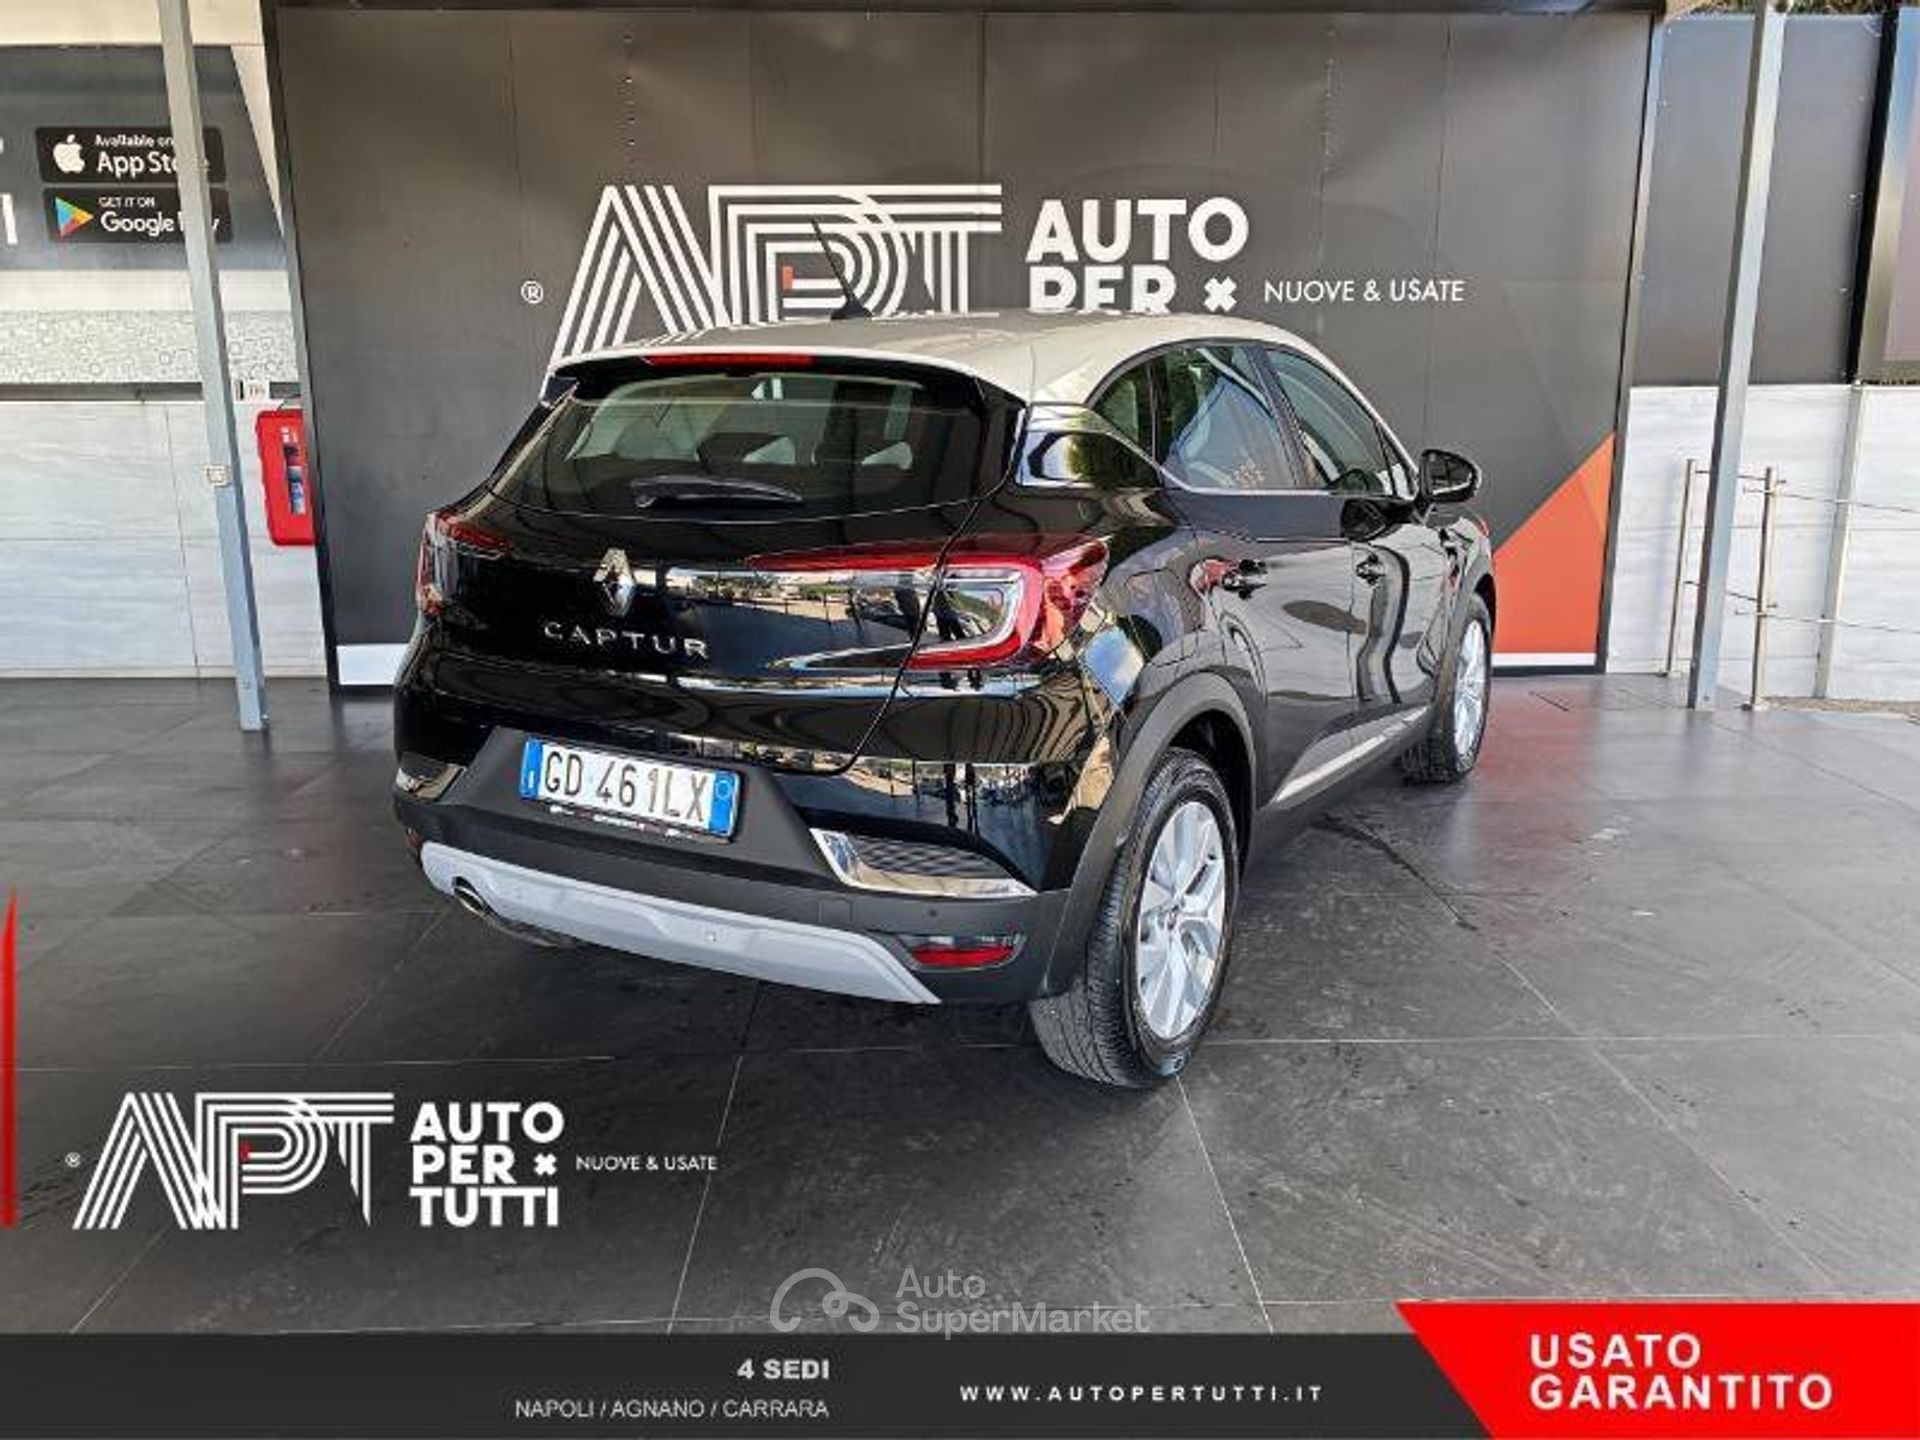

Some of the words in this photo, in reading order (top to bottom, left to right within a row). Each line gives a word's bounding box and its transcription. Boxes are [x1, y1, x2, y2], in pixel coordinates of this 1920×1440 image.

[95, 134, 156, 147] Available
[97, 151, 145, 178] App
[100, 211, 175, 236] Google
[1026, 197, 1249, 263] AUTO
[1029, 264, 1177, 315] PER
[1264, 280, 1355, 303] NUOVE
[1362, 280, 1382, 302] &
[1389, 280, 1467, 303] USATE
[544, 622, 708, 659] CAPTUR
[545, 751, 583, 796] GD
